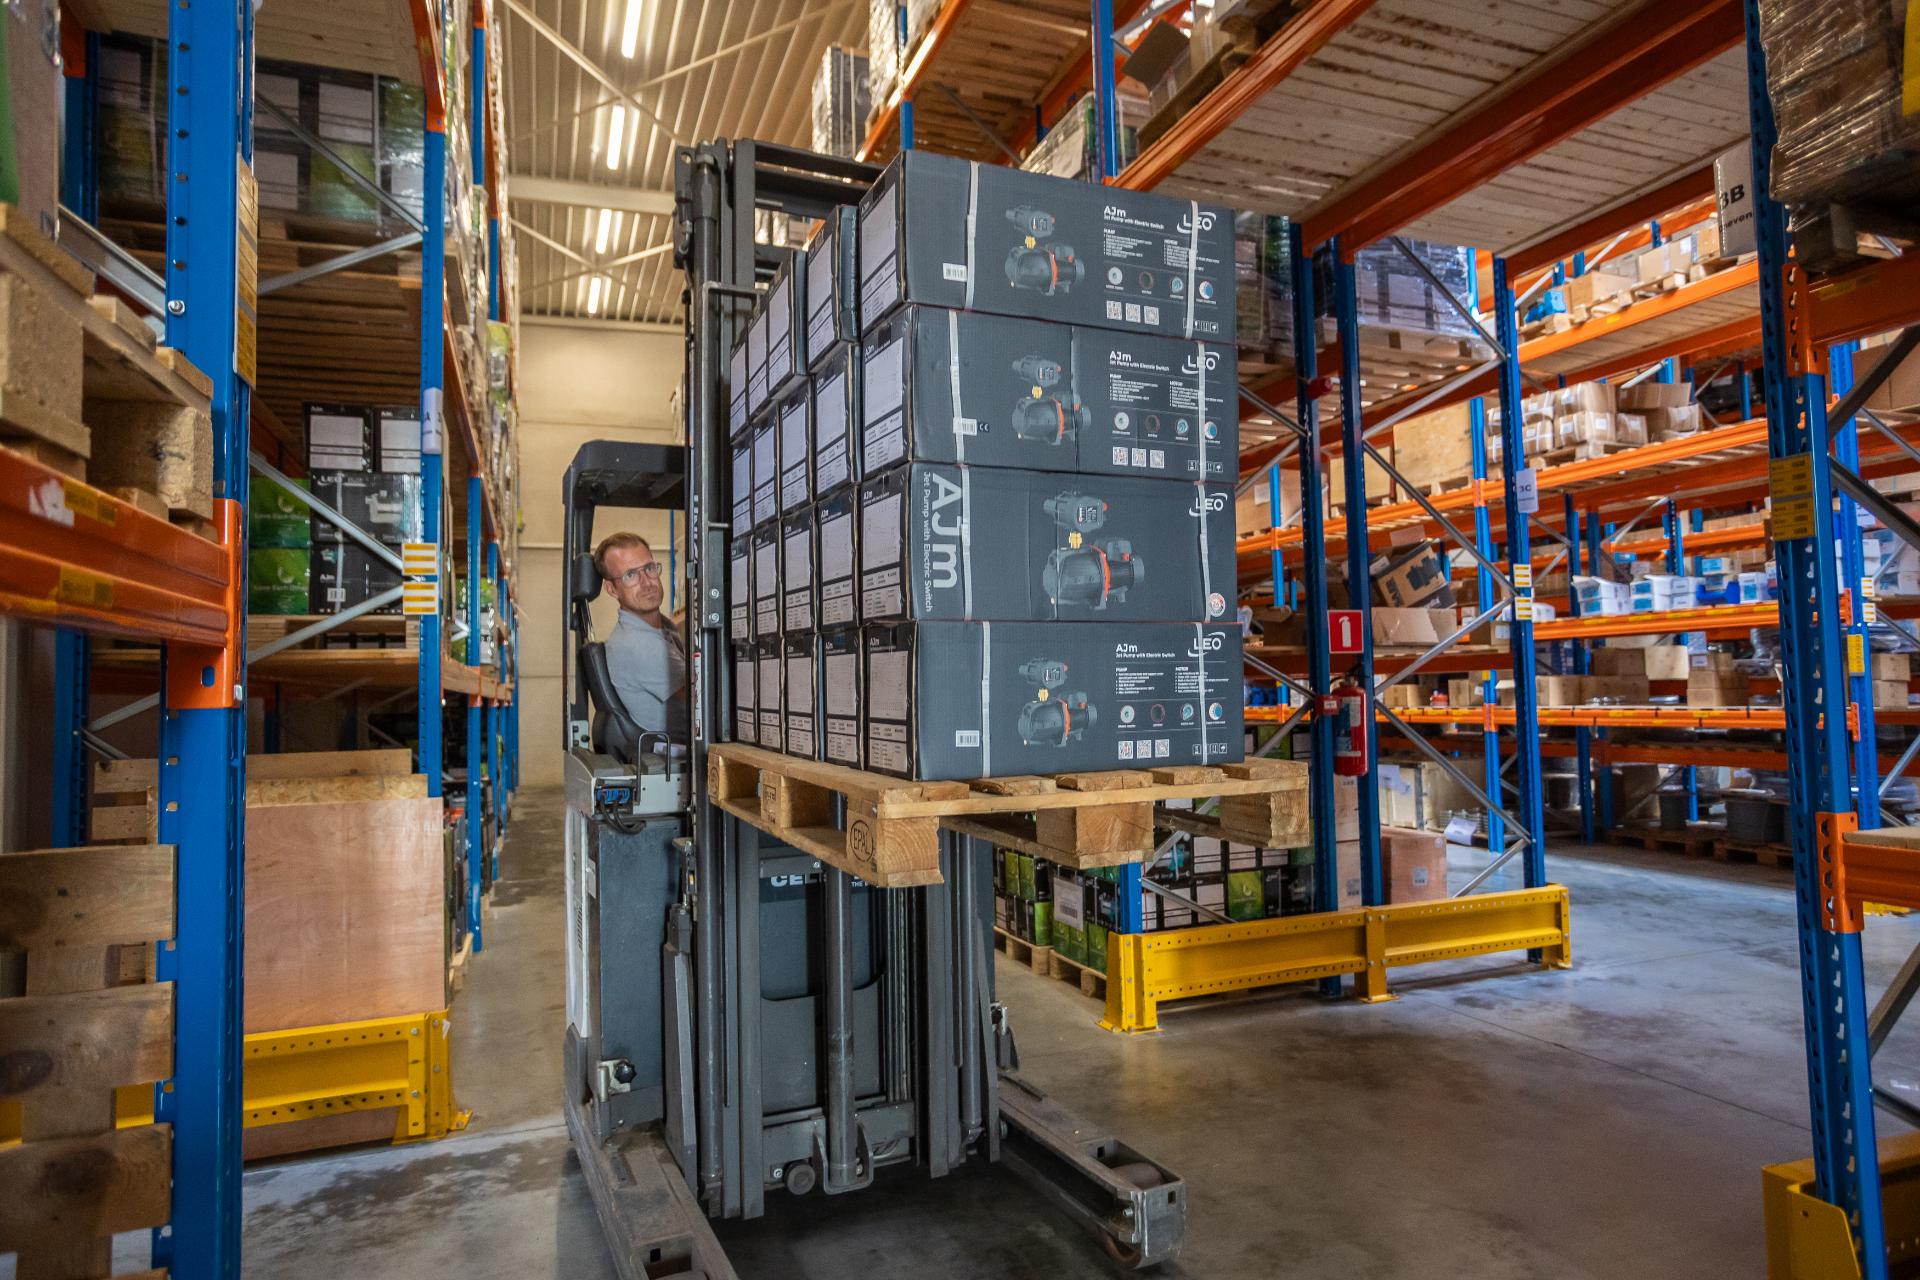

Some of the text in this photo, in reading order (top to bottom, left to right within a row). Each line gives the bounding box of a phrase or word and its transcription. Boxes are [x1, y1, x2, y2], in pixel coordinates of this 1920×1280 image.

[1104, 205, 1126, 218] AJm
[1109, 350, 1132, 362] AJm
[1187, 355, 1216, 371] LO
[931, 472, 962, 589] AJm
[922, 471, 933, 612] Jet Pump with Electric Switch
[1116, 643, 1138, 653] AJm
